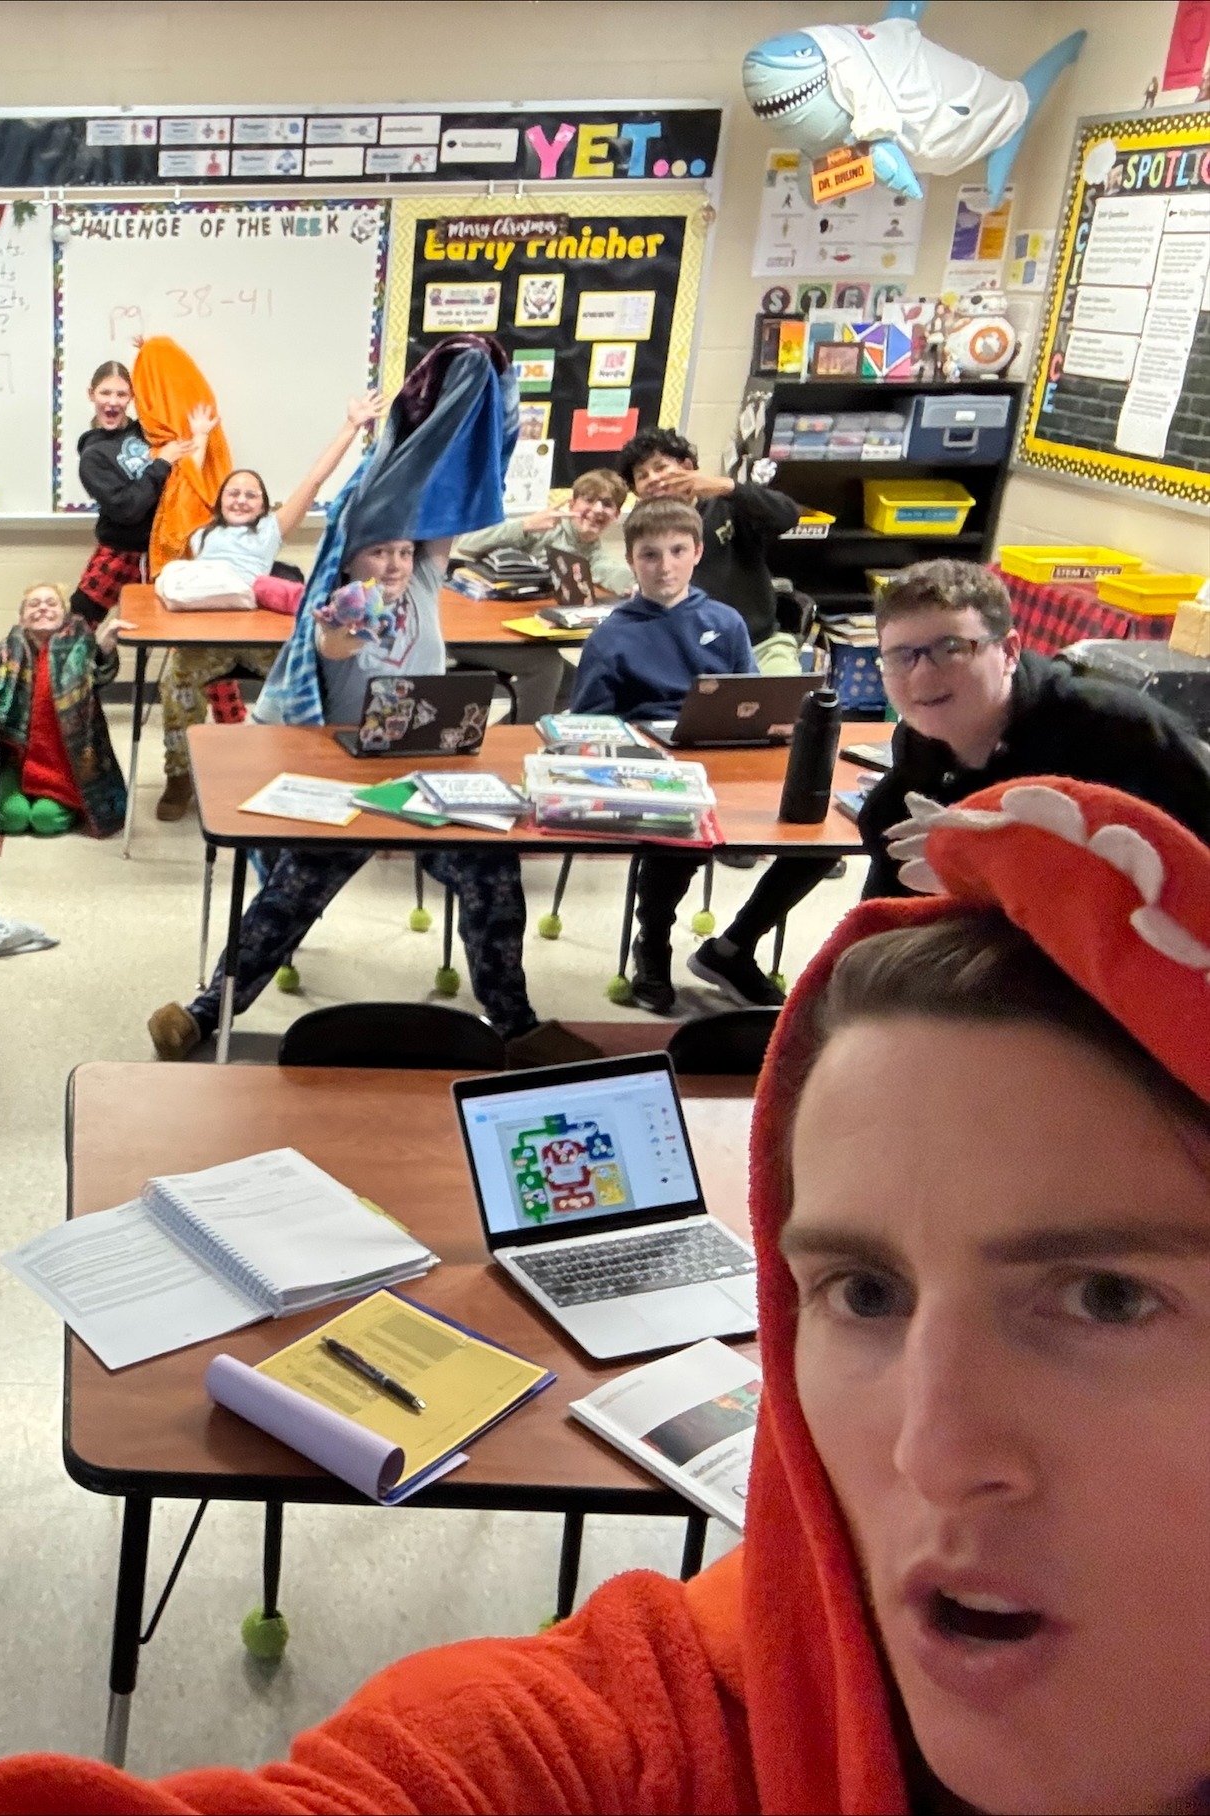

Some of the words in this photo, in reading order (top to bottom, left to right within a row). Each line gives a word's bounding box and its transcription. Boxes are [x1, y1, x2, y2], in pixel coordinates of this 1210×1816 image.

[818, 177, 833, 192] DR.
[835, 165, 865, 185] BRUNO
[69, 216, 182, 241] CHALLENGE
[200, 217, 225, 239] OF
[236, 215, 272, 238] THE
[280, 214, 339, 237] WEEK
[493, 217, 558, 237] Christmas
[423, 229, 515, 271] Early
[527, 226, 665, 259] Finisher
